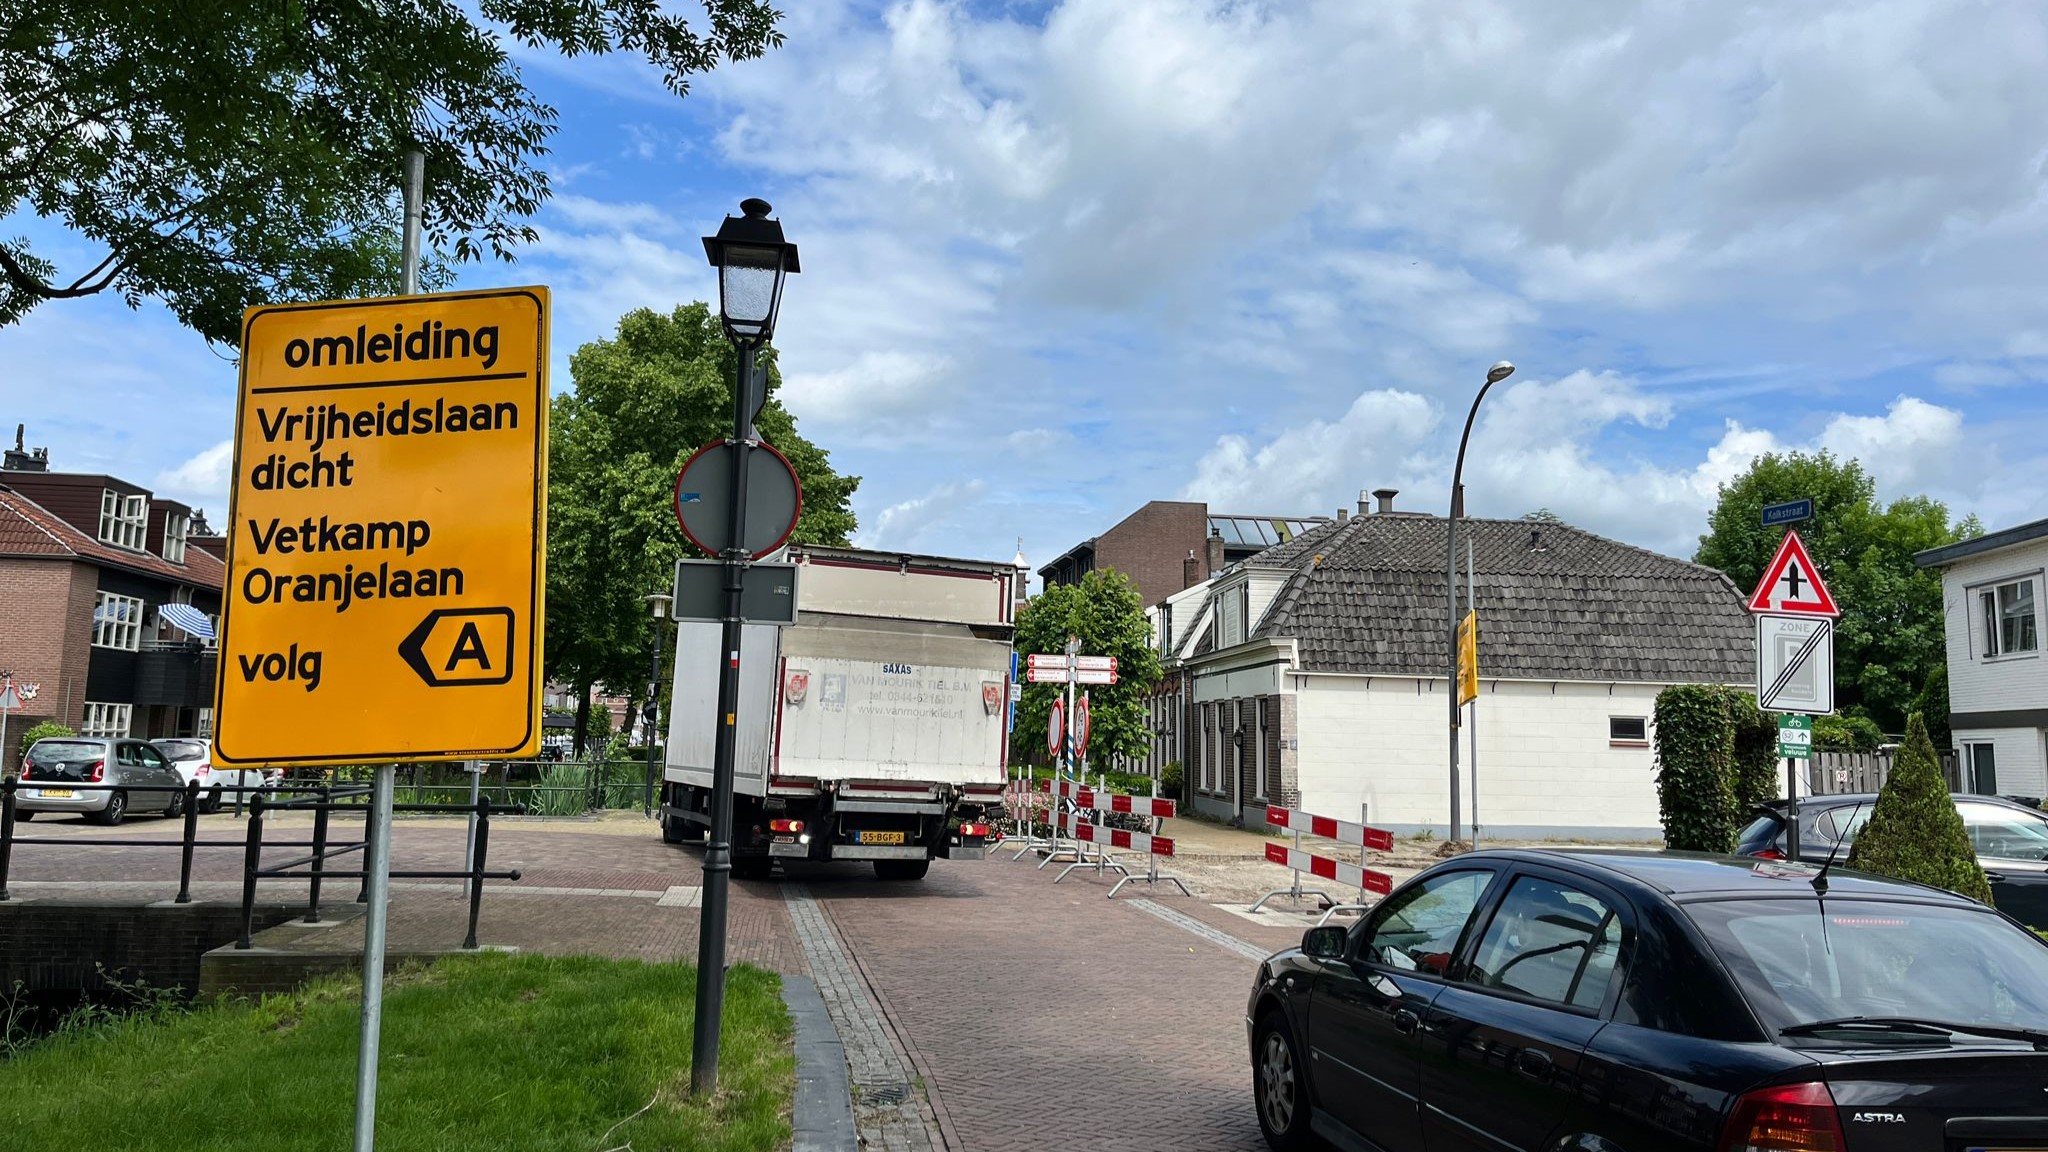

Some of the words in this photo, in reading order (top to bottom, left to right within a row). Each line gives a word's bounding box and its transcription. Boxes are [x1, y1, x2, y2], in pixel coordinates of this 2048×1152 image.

[285, 320, 499, 369] omleiding
[257, 398, 518, 452] Vrijheidslaan
[251, 452, 354, 490] dicht
[1767, 506, 1803, 521] Kolkstraat
[249, 516, 431, 556] Vetkamp
[243, 563, 464, 612] Oranjelaan
[445, 622, 491, 671] A
[1780, 622, 1810, 633] ZONE
[239, 643, 321, 692] volg
[851, 674, 874, 686] VAN
[878, 676, 923, 688] MOURIK
[928, 680, 950, 691] TIEL
[863, 832, 901, 842] 55-BGF-3
[1852, 1112, 1906, 1123] ASTRA
